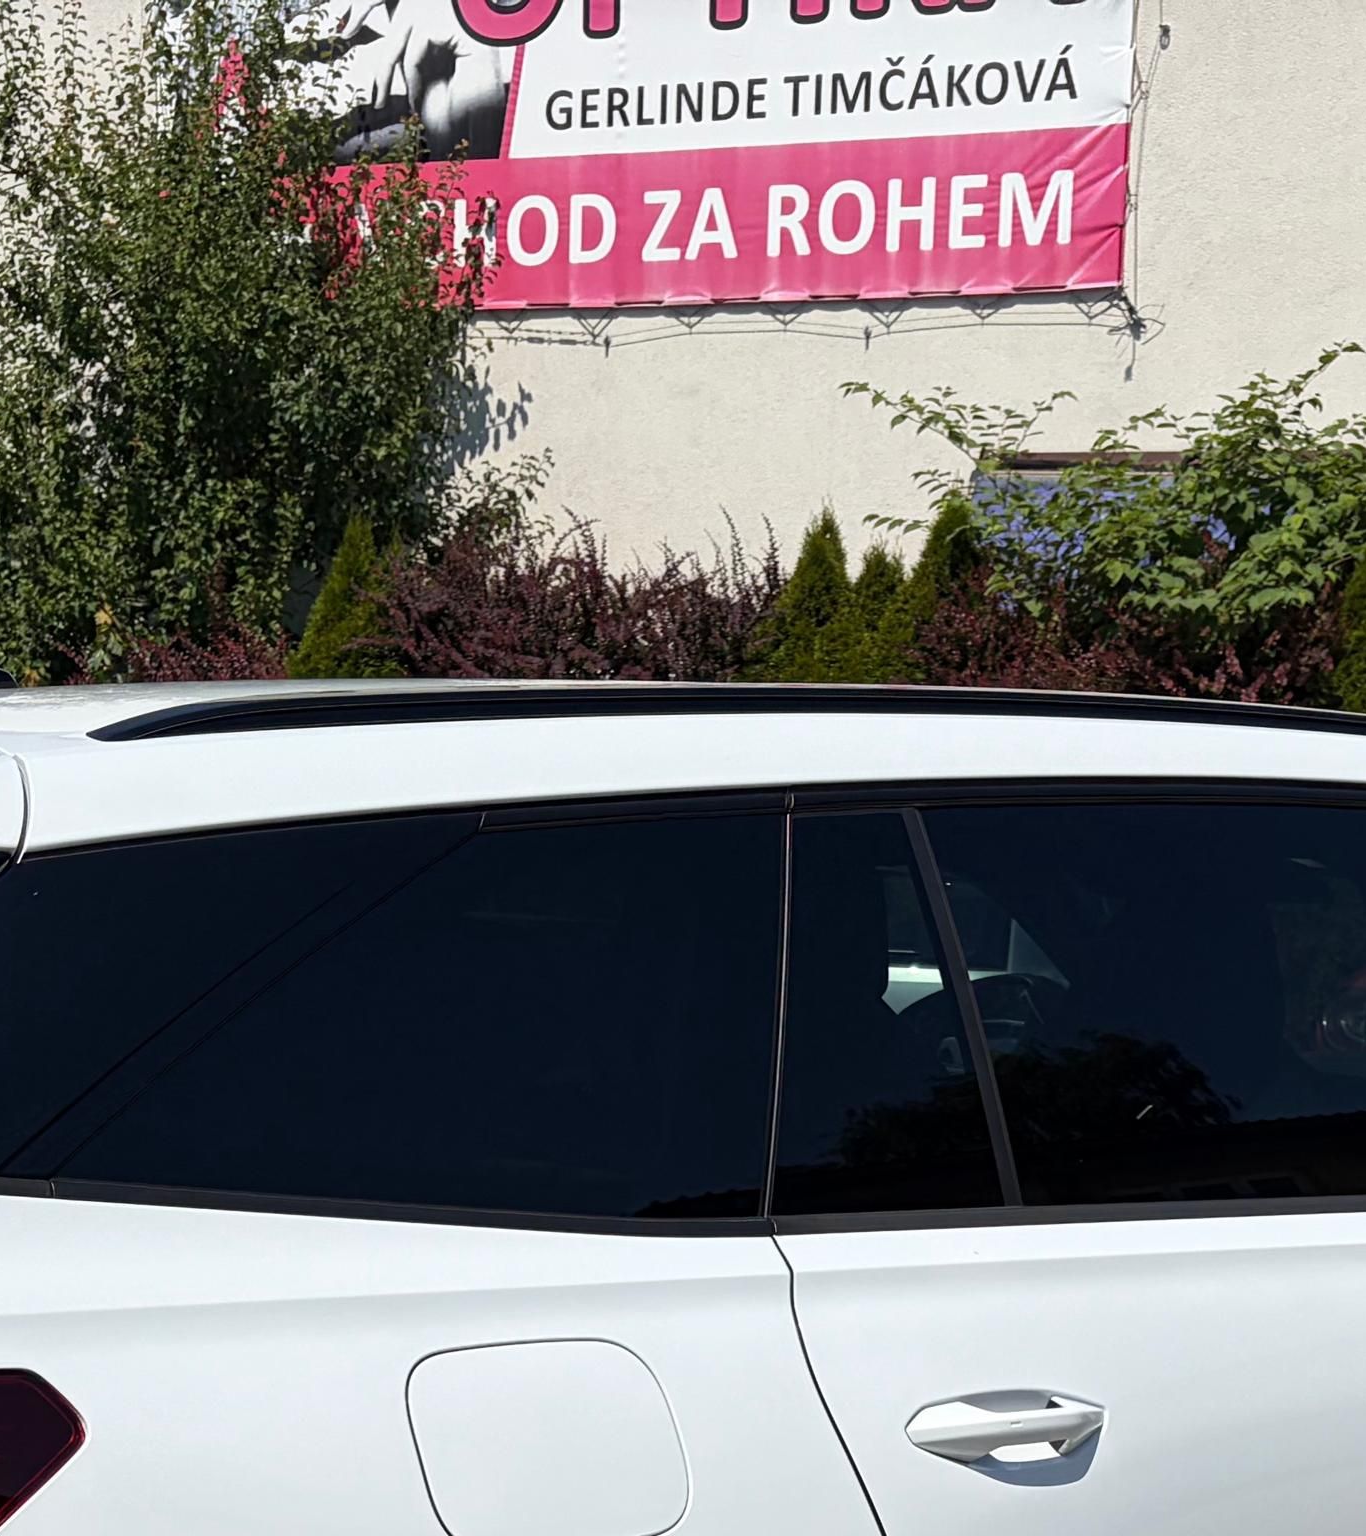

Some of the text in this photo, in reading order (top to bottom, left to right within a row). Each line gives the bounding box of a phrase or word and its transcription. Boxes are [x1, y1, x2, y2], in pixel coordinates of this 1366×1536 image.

[545, 44, 1079, 131] GERLINDE TIMČÁKOVÁ
[641, 187, 738, 263] ZA
[767, 169, 1075, 258] ROHEM
